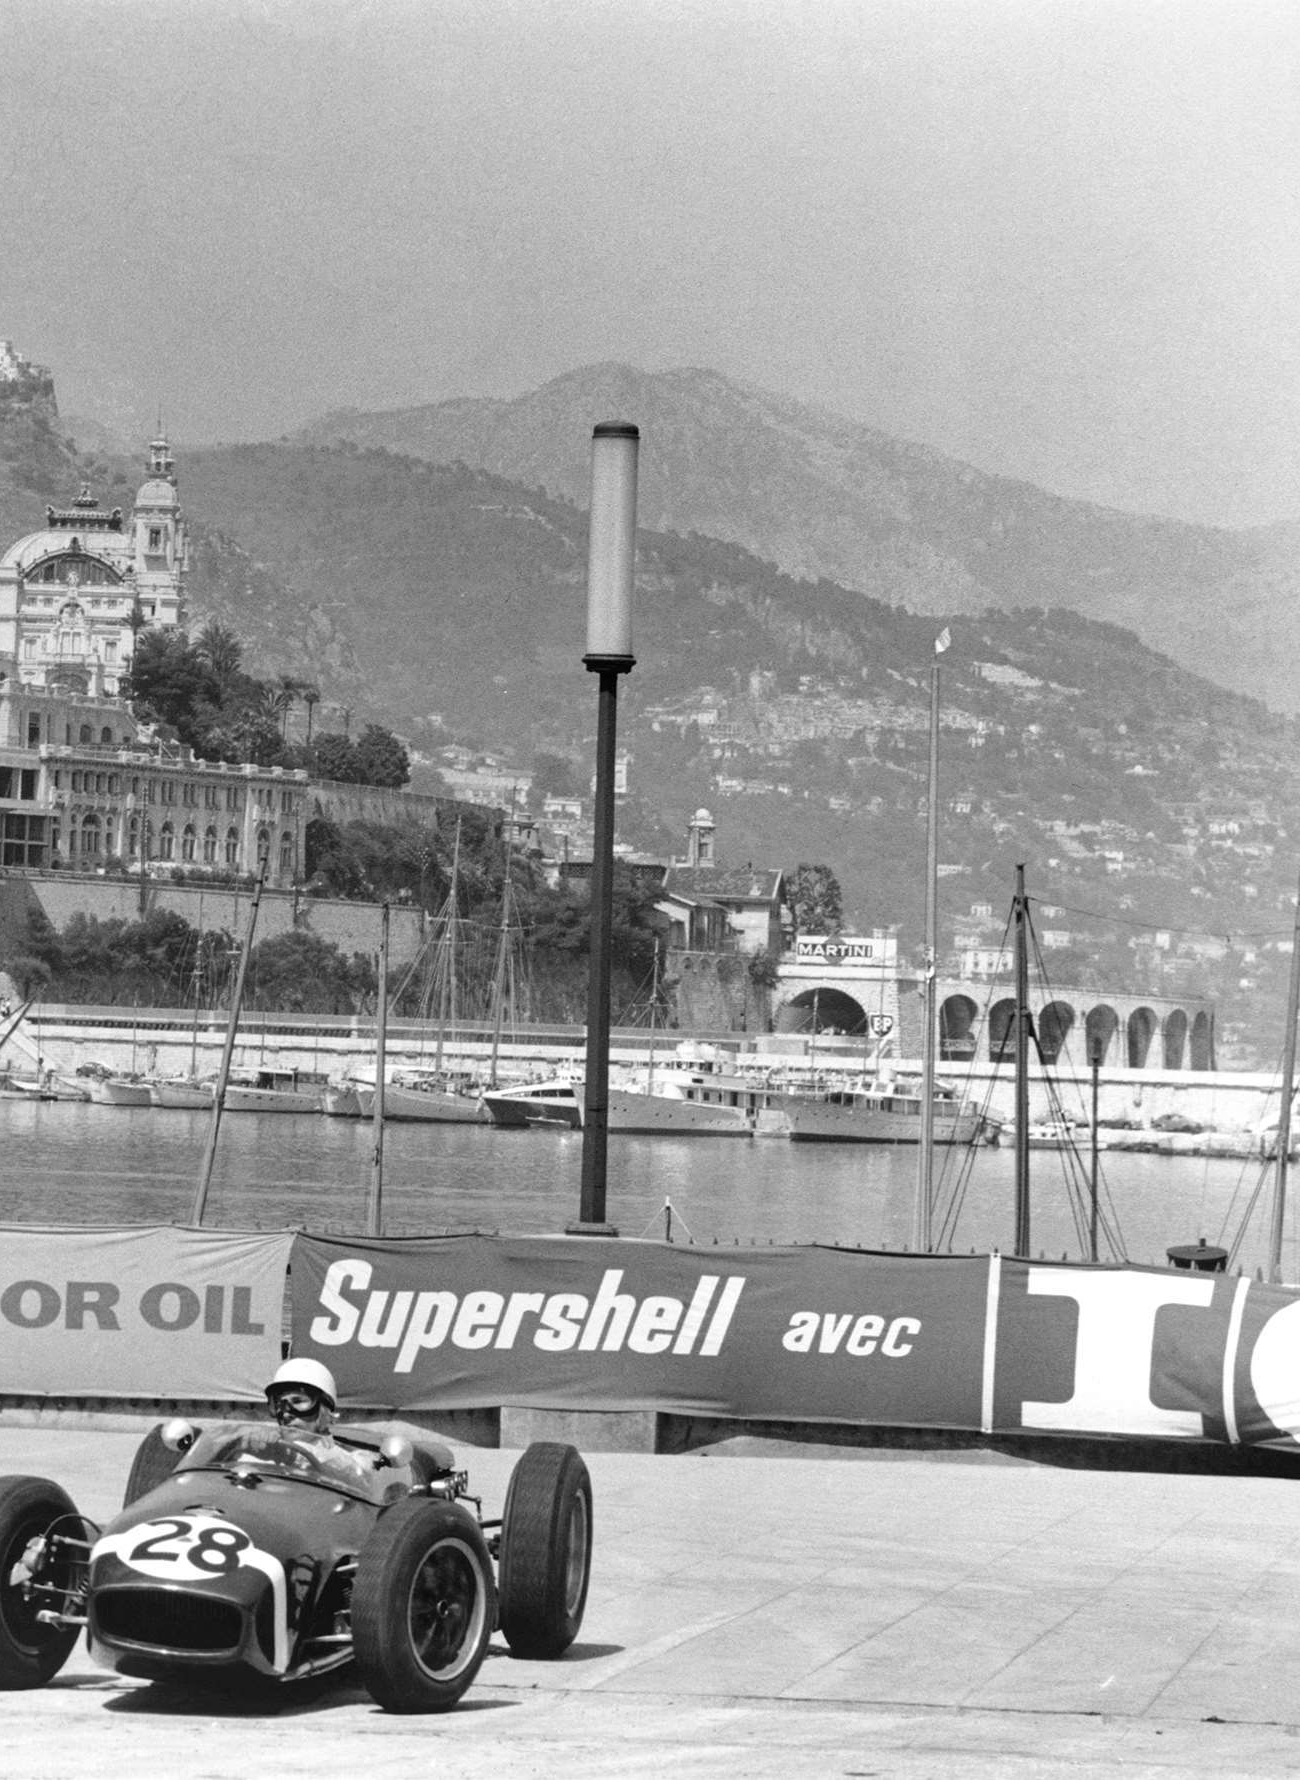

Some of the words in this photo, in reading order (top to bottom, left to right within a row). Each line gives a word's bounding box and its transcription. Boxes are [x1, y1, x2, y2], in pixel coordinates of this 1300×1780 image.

[799, 943, 872, 957] MARTINI
[873, 1016, 892, 1033] BP
[138, 1282, 265, 1336] OIL
[310, 1258, 747, 1374] Supershell
[781, 1310, 922, 1358] avec
[128, 1519, 250, 1574] 28
